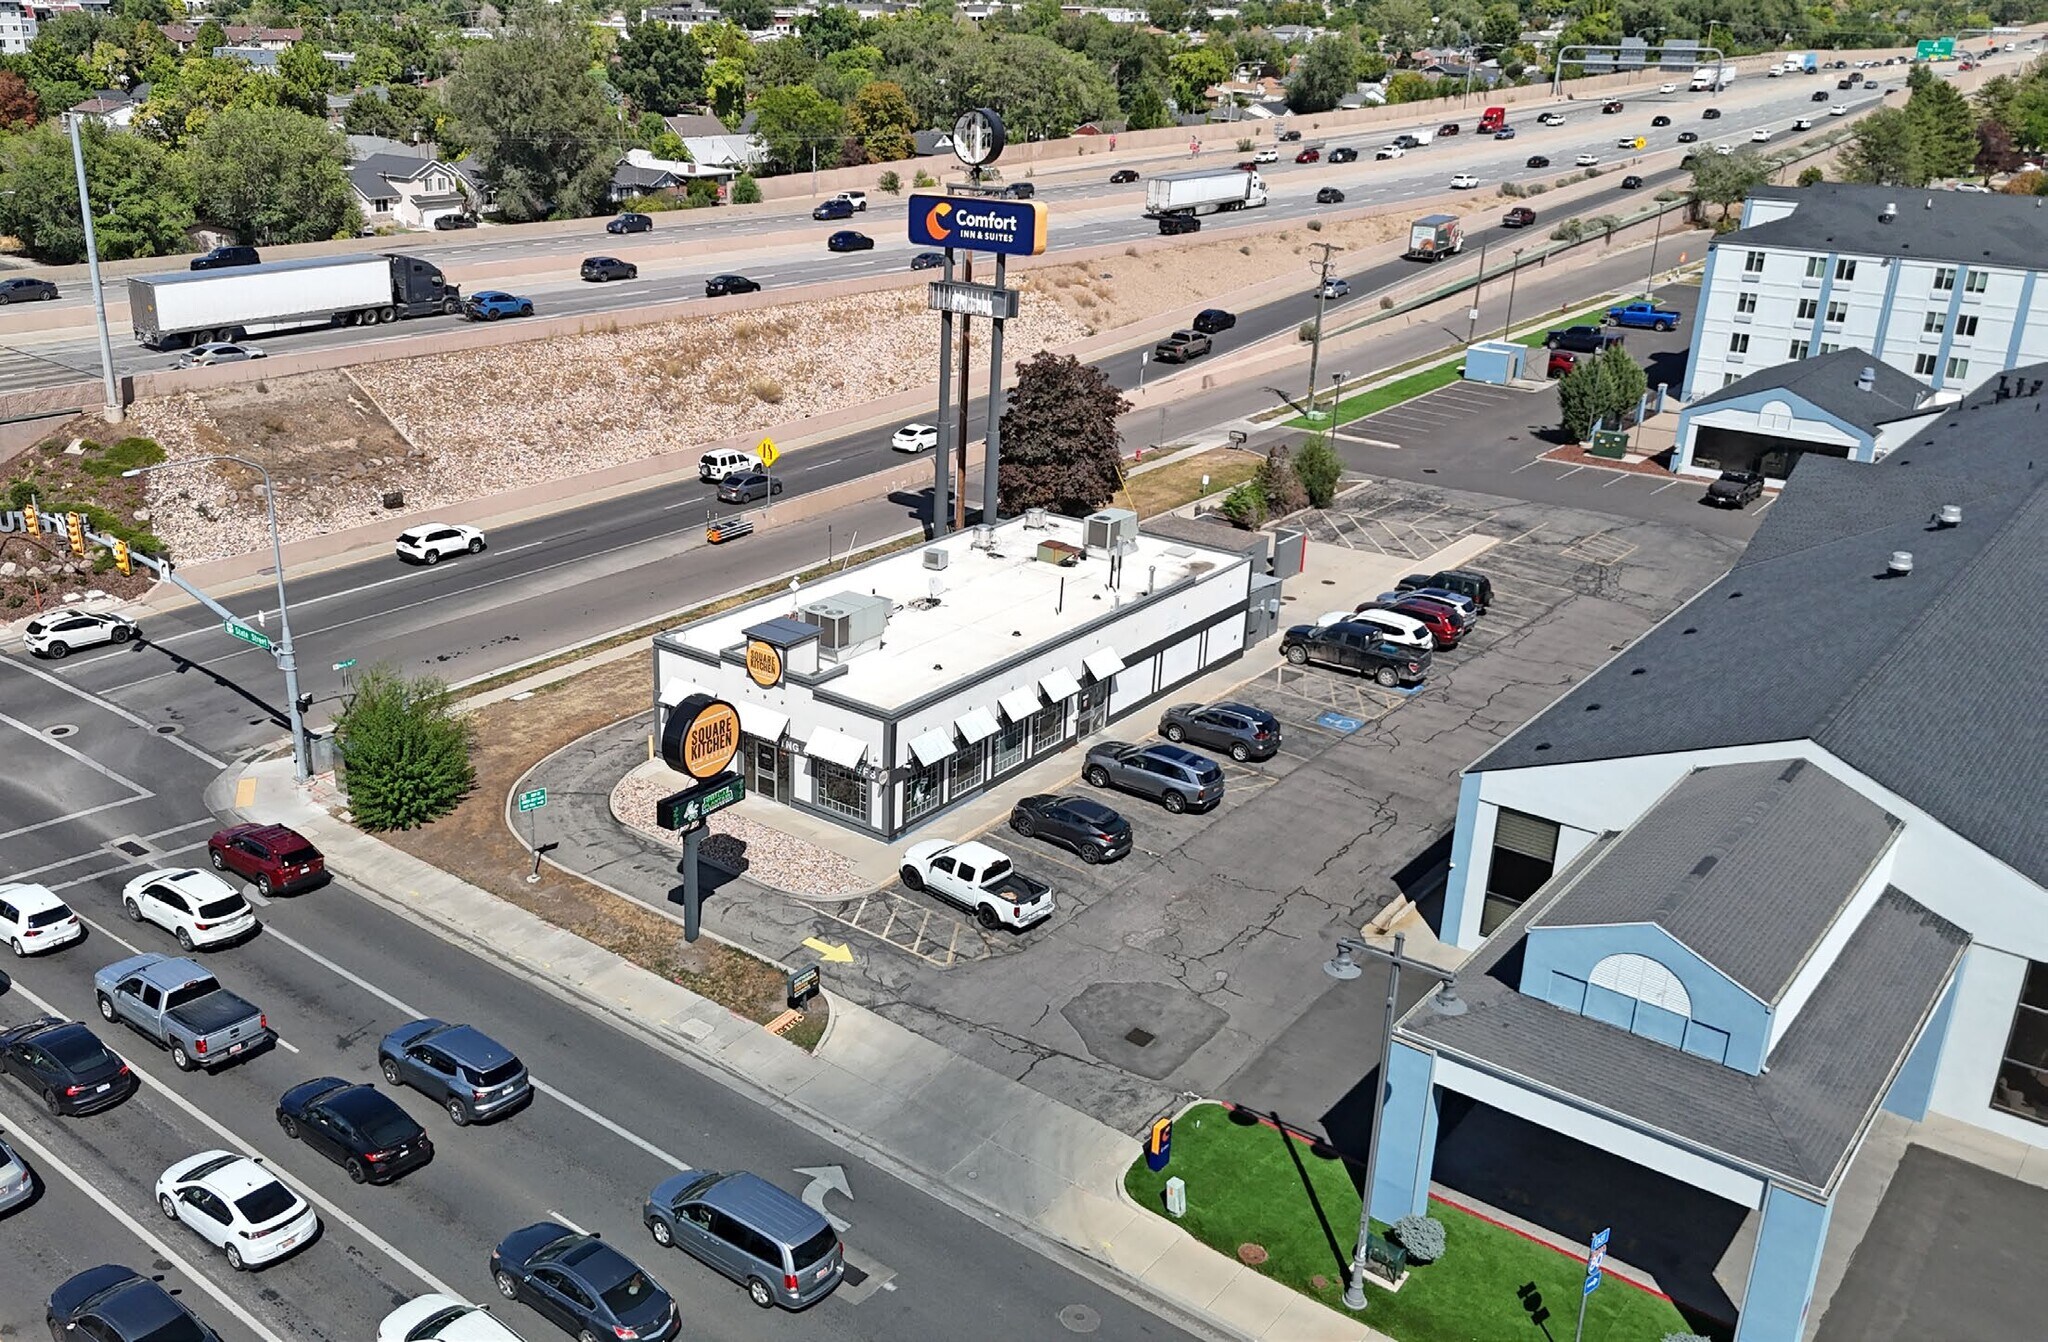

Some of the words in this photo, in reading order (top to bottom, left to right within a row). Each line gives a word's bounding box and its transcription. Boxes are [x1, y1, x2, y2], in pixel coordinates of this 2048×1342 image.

[955, 209, 1017, 231] Comfort
[960, 229, 976, 239] INN
[976, 230, 983, 240] &
[984, 232, 1014, 243] SUITES
[235, 626, 250, 640] State
[250, 632, 269, 648] Street
[750, 650, 776, 665] SQUARE
[750, 659, 776, 675] KITCHEN
[691, 717, 732, 747] SQUARE
[690, 731, 732, 761] KITCHEN
